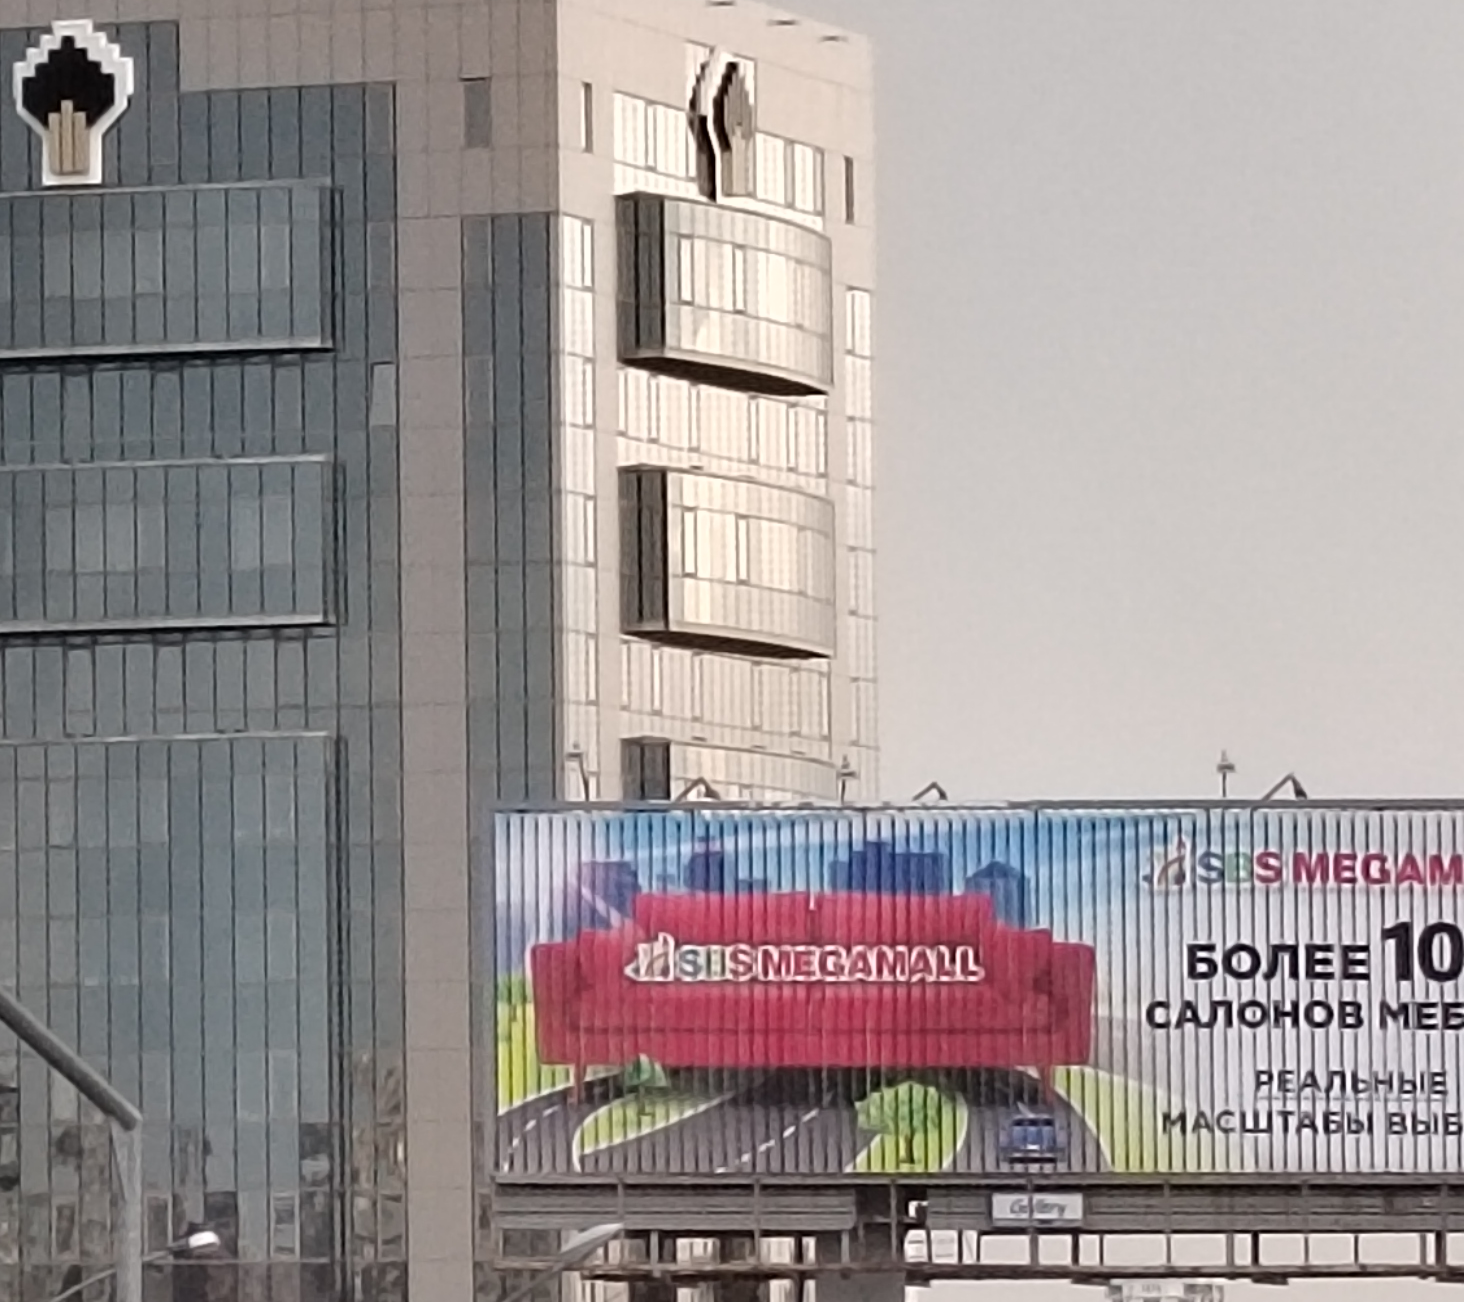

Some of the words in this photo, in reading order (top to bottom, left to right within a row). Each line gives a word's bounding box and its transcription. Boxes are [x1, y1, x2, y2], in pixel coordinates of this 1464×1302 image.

[1198, 850, 1283, 885] SBS
[757, 945, 985, 982] MEGAMALL
[1186, 943, 1371, 981] БОЛЕЕ
[1145, 999, 1365, 1030] САЛОНОВ
[1254, 1069, 1449, 1097] РЕАЛЬНЫЕ
[1161, 1109, 1374, 1137] МАСШТАБЫ
